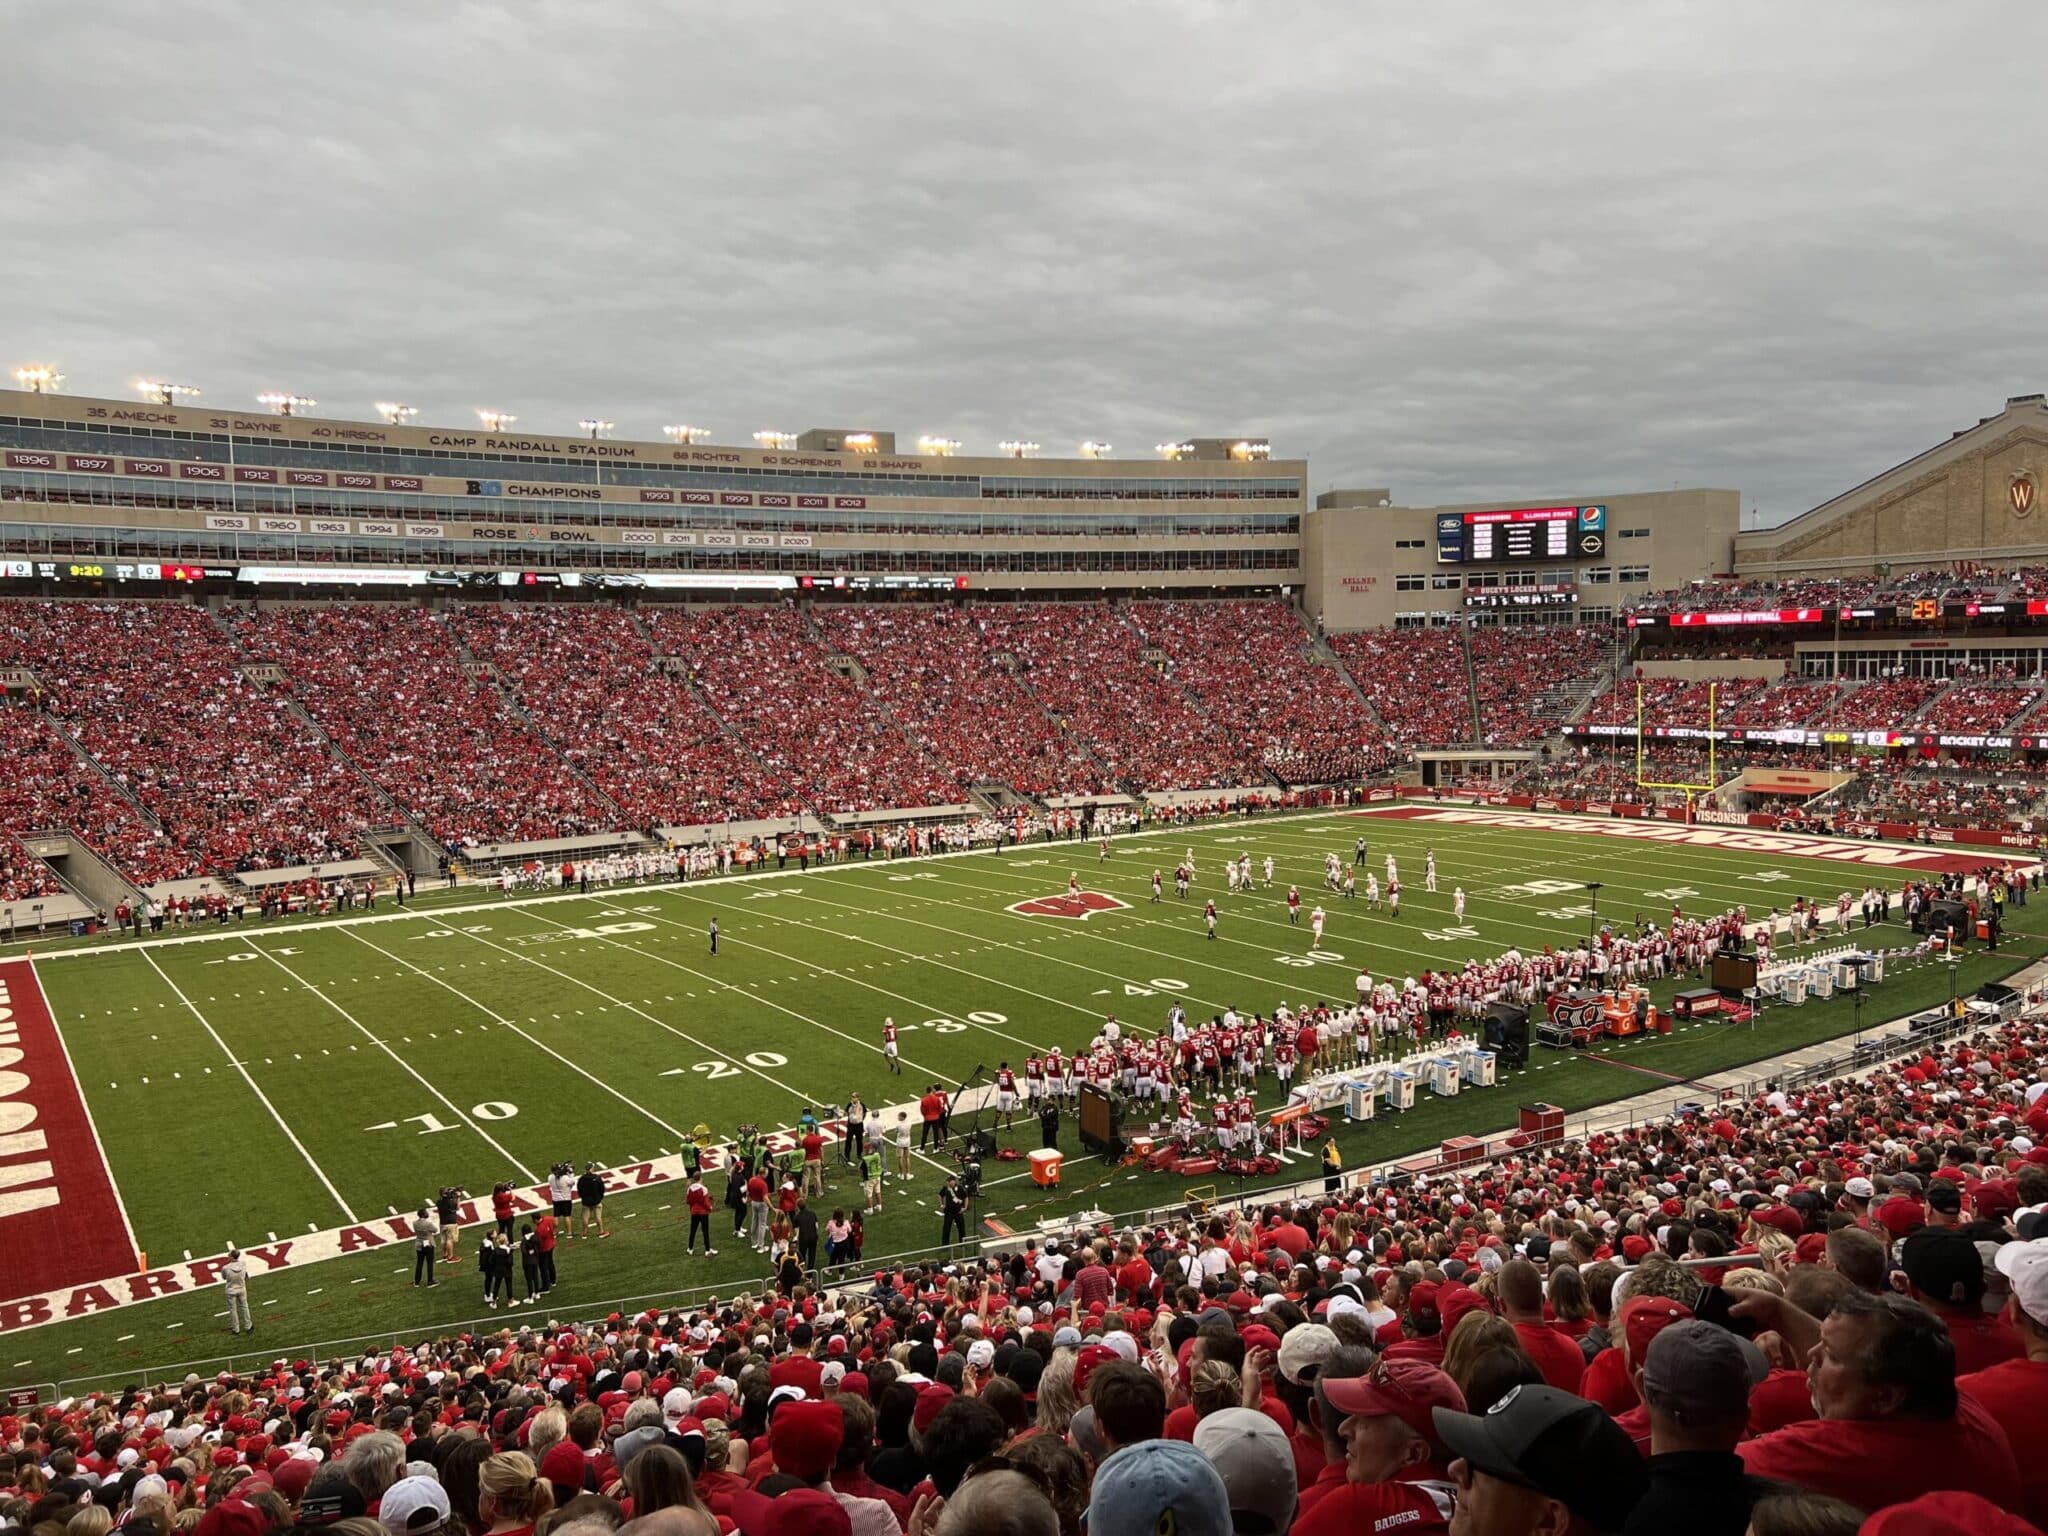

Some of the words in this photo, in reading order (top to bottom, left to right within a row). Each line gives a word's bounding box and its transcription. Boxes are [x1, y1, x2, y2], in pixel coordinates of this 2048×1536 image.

[88, 408, 107, 417] 35
[112, 410, 177, 425] AMECHE
[210, 418, 228, 429] 33
[234, 420, 281, 433] DAYNE
[312, 428, 331, 437] 40
[336, 429, 386, 441] HIRSCH
[430, 436, 476, 448] CAMP
[486, 439, 560, 452] RANDALL
[569, 444, 635, 457] STADIUM
[14, 455, 50, 466] 1896
[692, 452, 740, 462] RICHTER
[780, 456, 841, 468] SCHREINER
[75, 458, 107, 470] 1897
[134, 463, 163, 473] 1901
[880, 461, 922, 470] SHAFER
[187, 466, 220, 477] 1906
[243, 470, 270, 480] 1912
[294, 473, 322, 483] 1952
[343, 476, 371, 486] 1959
[391, 479, 418, 488] 1962
[508, 485, 601, 499] CHAMPIONS
[646, 491, 670, 501] 1993
[686, 493, 710, 502] 1998
[2012, 485, 2031, 508] W
[725, 495, 749, 504] 1999
[764, 496, 787, 505] 2010
[803, 497, 823, 506] 2011
[840, 498, 861, 507] 2012
[213, 518, 244, 528] 1953
[265, 521, 296, 531] 1960
[316, 523, 345, 532] 1963
[365, 525, 392, 534] 1994
[411, 526, 439, 535] 1999
[473, 528, 516, 539] ROSE
[550, 531, 595, 542] BOWL
[624, 533, 654, 542] 2000
[670, 535, 690, 543] 2011
[708, 536, 731, 544] 2012
[747, 537, 769, 545] 2013
[784, 538, 809, 546] 2020
[70, 565, 103, 577] 9:20
[1912, 602, 1936, 619] 25
[1940, 736, 1984, 746] ROCKET
[1987, 737, 2012, 747] CAN
[2001, 835, 2033, 846] meijer
[1421, 925, 1480, 942] 40
[1273, 950, 1345, 968] 50
[1124, 978, 1190, 997] 40
[923, 1011, 1009, 1033] 30
[1622, 1017, 1630, 1031] G
[692, 1052, 788, 1079] 20
[404, 1102, 518, 1135] 10
[1141, 1145, 1150, 1155] G
[1045, 1163, 1057, 1177] G
[0, 1242, 293, 1331] BARRY
[1374, 1510, 1421, 1532] BADGERS
